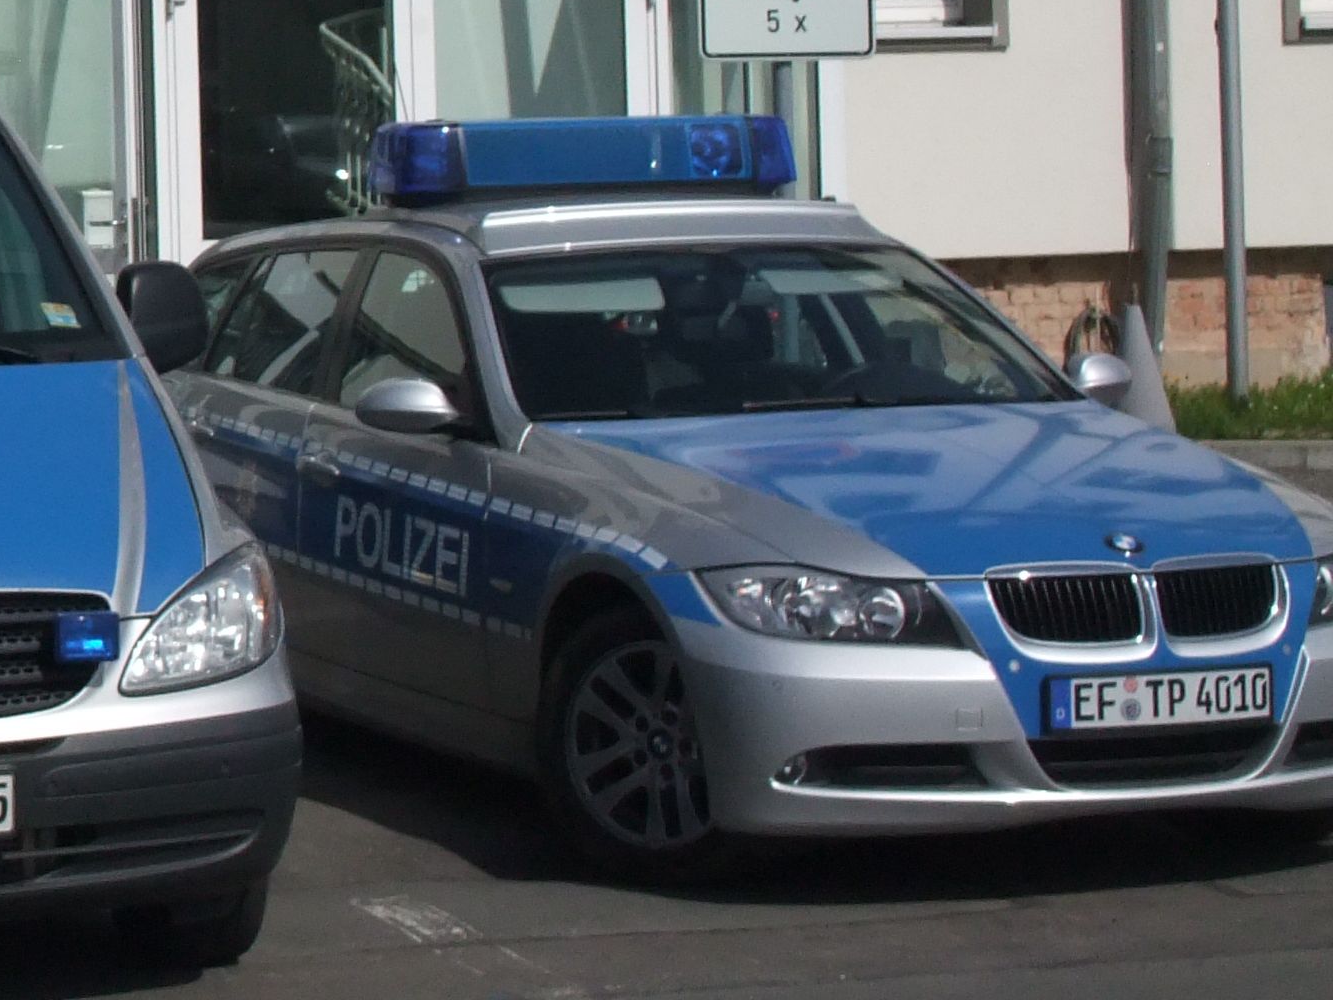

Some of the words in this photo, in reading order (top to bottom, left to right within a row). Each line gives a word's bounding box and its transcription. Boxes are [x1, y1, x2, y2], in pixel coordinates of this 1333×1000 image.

[766, 8, 780, 33] 5
[794, 14, 807, 33] x
[334, 494, 470, 598] POLIZEI
[1073, 681, 1118, 722] EF
[1144, 678, 1186, 718] TP
[1196, 672, 1268, 715] 4010
